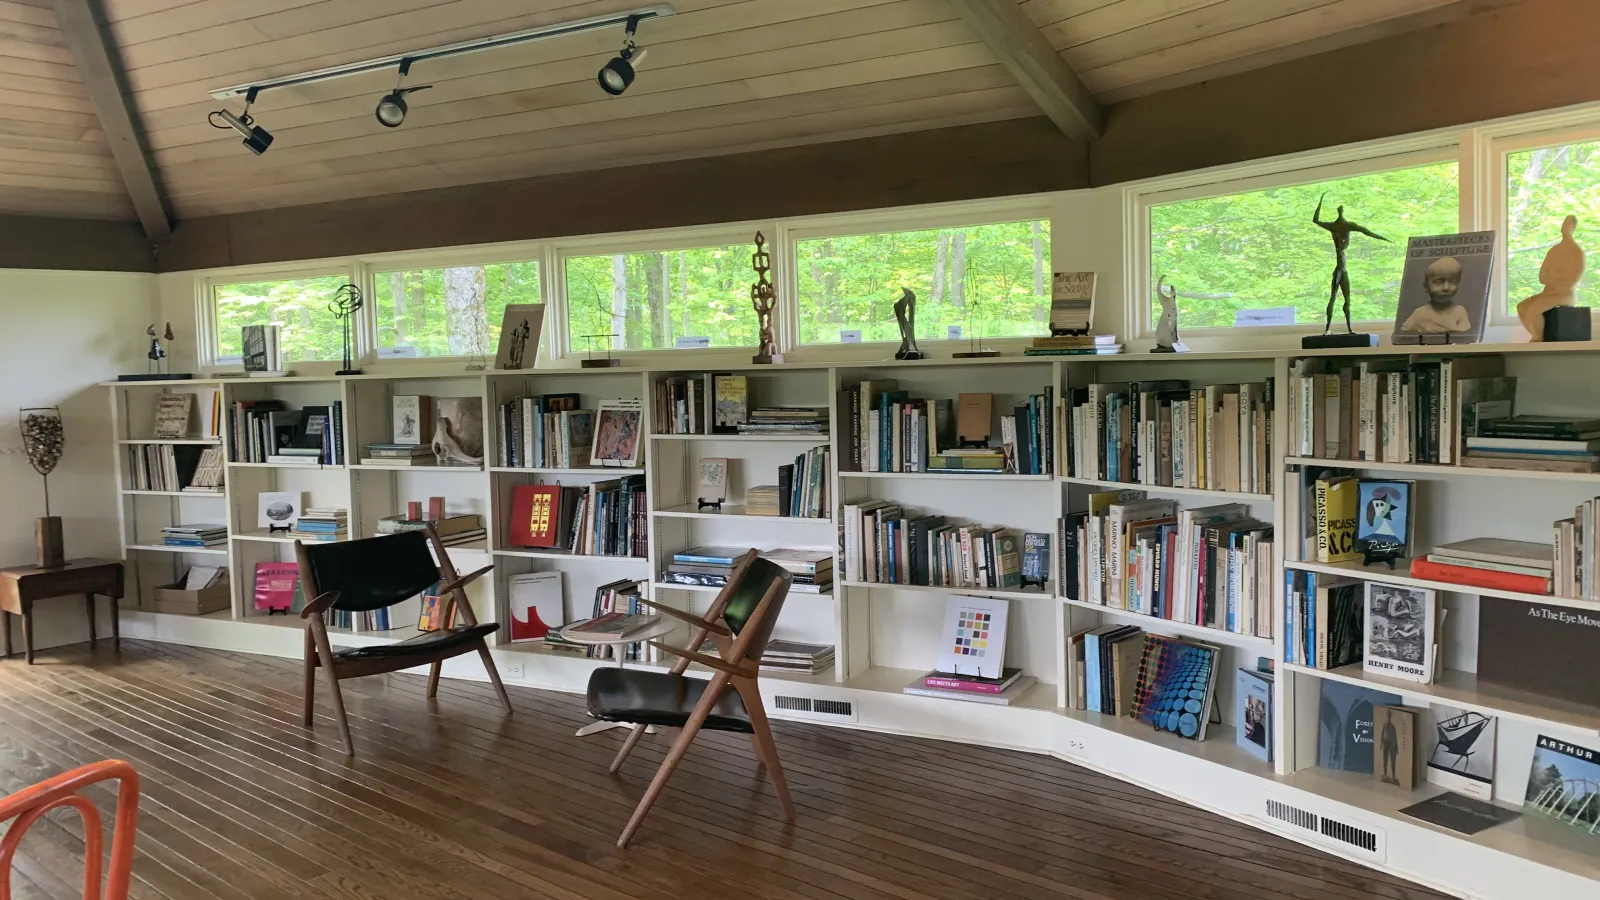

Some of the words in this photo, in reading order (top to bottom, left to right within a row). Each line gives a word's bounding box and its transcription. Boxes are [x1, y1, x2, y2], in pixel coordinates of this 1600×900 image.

[1411, 234, 1491, 248] MASTERPIECES
[1410, 249, 1424, 257] OF
[1428, 245, 1490, 257] SCULPTURE
[1075, 272, 1090, 282] Art
[1063, 282, 1091, 298] Seeing
[1391, 374, 1399, 405] Sculpture
[1317, 487, 1327, 527] PICASSO
[1328, 517, 1356, 531] PICASS
[1319, 536, 1327, 551] CO.
[1528, 607, 1540, 617] As
[1541, 608, 1558, 620] The
[1559, 611, 1576, 624] Eye
[1368, 659, 1394, 671] HENRY
[1397, 664, 1425, 677] MOORE
[1540, 738, 1593, 760] ARTHUR
